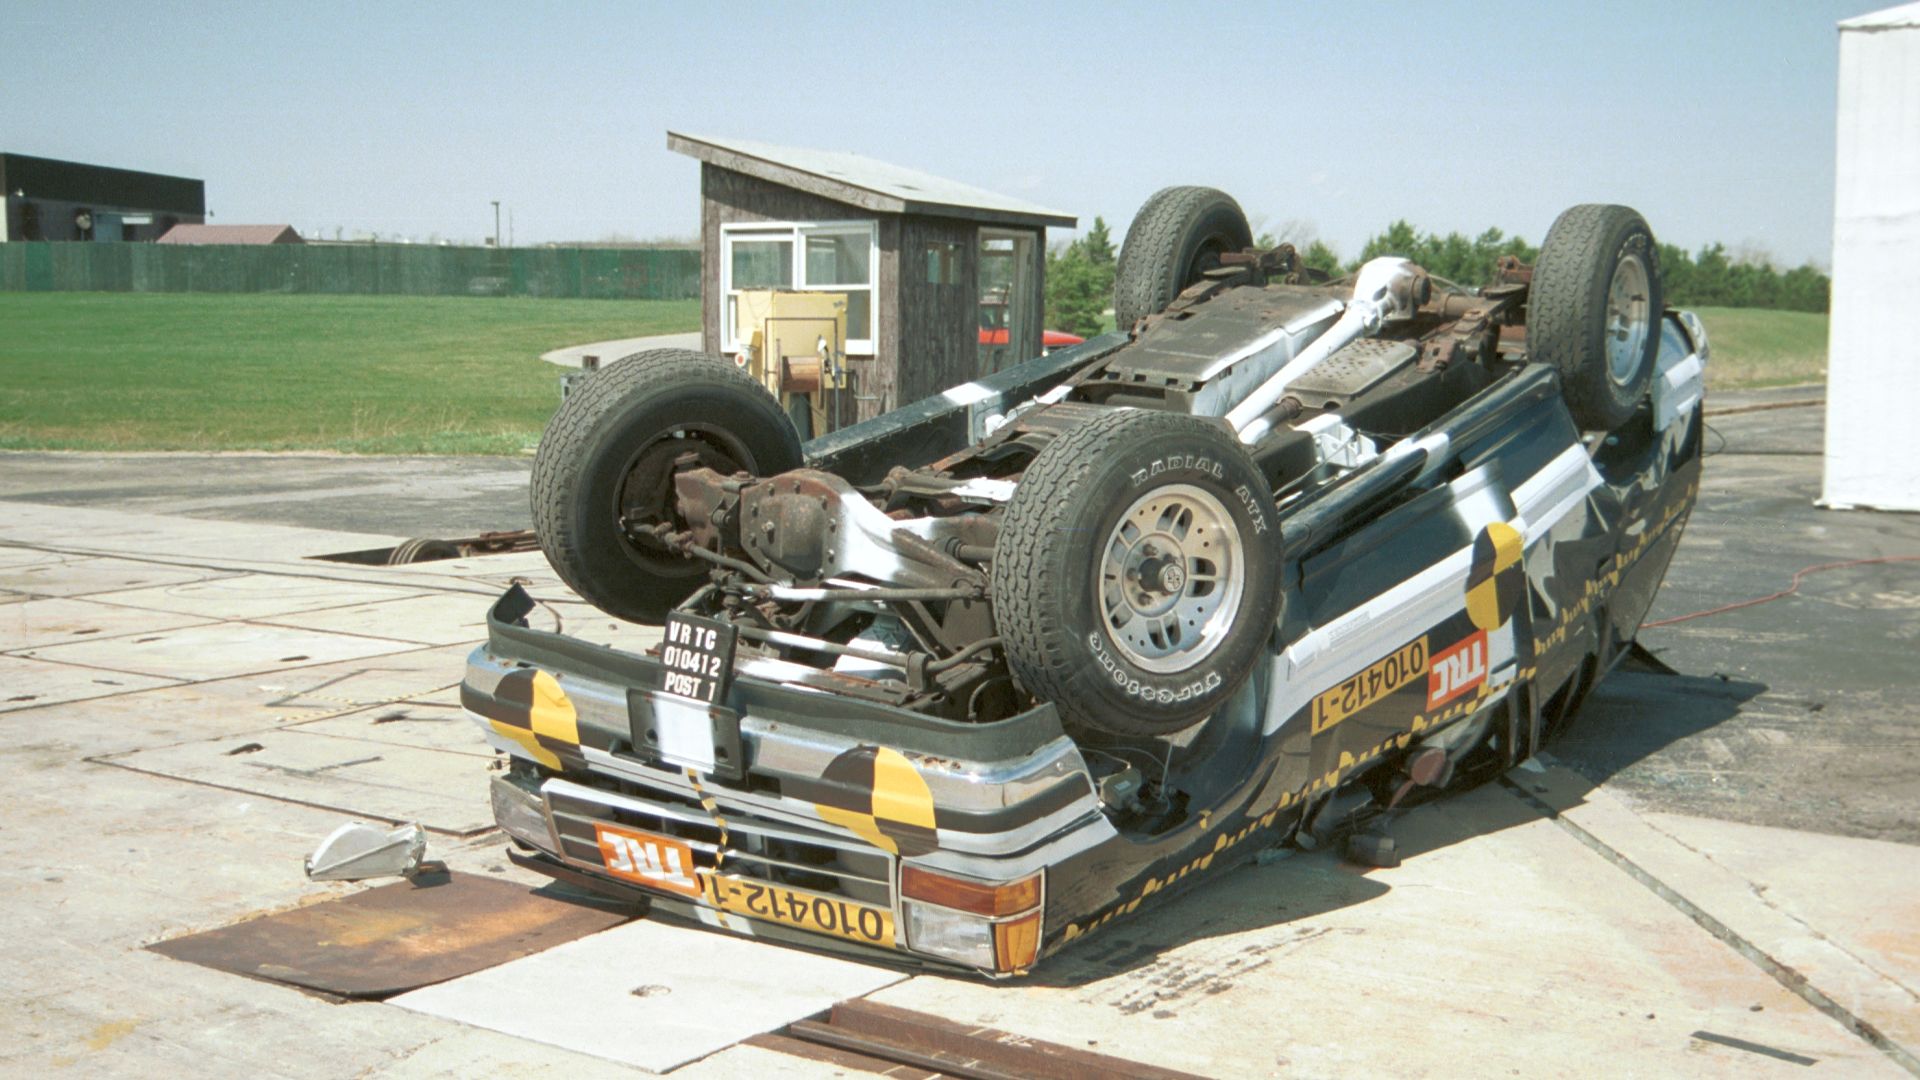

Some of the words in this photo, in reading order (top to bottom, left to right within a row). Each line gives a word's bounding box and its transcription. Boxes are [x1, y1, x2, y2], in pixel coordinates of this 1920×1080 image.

[1131, 454, 1224, 487] RADIAL
[1235, 484, 1268, 535] ATX
[663, 645, 722, 678] 010412
[664, 671, 702, 698] POST
[707, 681, 717, 702] 1
[1317, 641, 1424, 729] 010412-1
[1431, 639, 1486, 701] TRC
[601, 830, 696, 889] TRC
[709, 875, 884, 942] 010412-1
